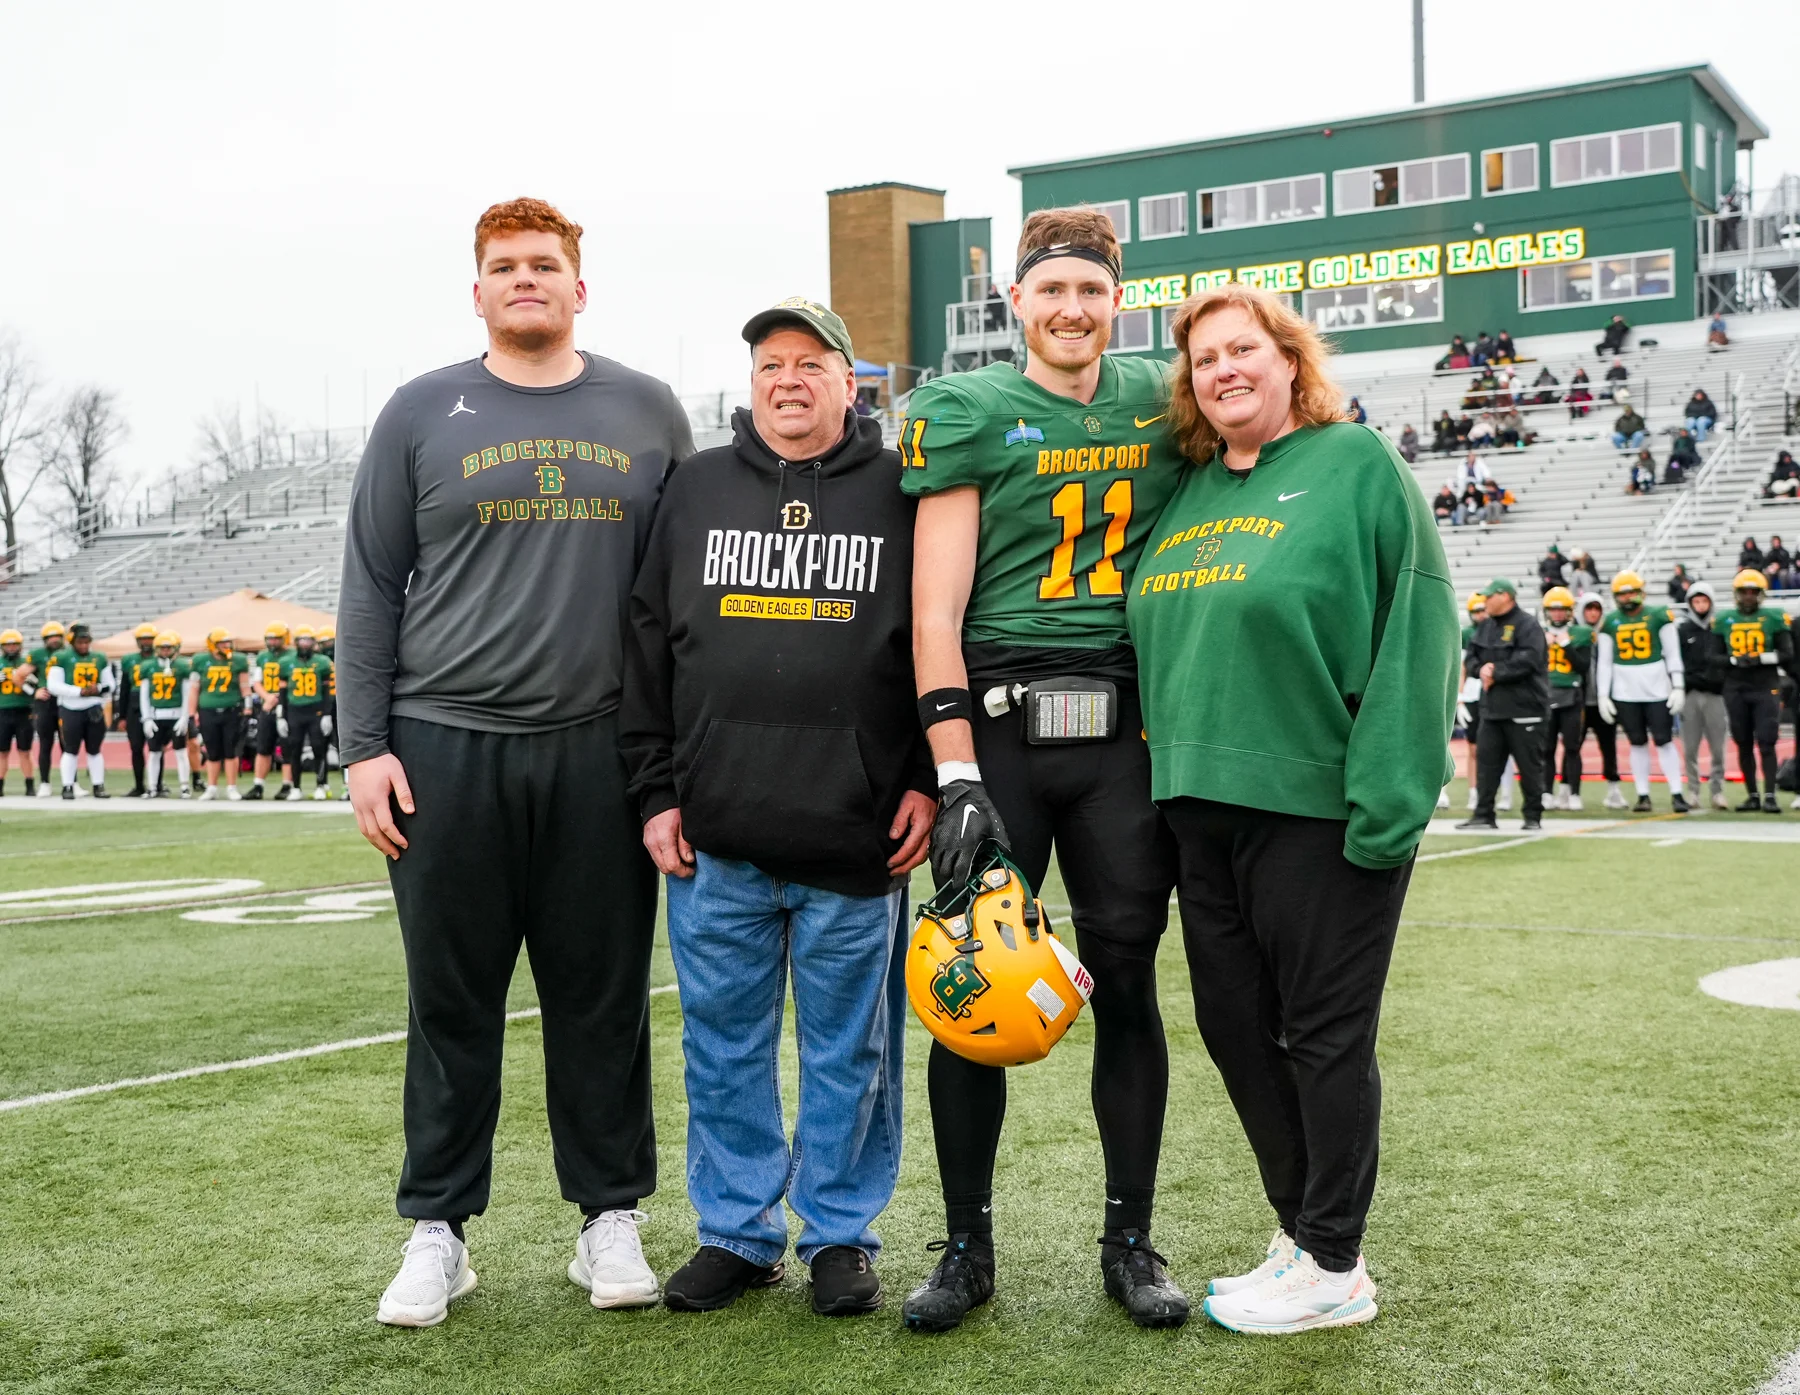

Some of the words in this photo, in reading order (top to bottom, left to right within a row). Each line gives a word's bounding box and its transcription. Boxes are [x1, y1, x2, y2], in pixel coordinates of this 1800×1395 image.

[1121, 275, 1185, 308] OME
[1238, 261, 1303, 293] THE
[1309, 246, 1440, 288] GOLDEN
[1447, 228, 1583, 273] EAGLES
[462, 439, 630, 479] BROCKPORT
[1036, 443, 1150, 475] BROCKPORT
[538, 463, 564, 494] B
[477, 498, 623, 524] FOOTBALL
[783, 501, 810, 529] B
[1036, 477, 1134, 601] 11
[1154, 516, 1285, 557] BROCKPORT
[703, 530, 884, 593] BROCKPORT
[1140, 563, 1247, 596] FOOTBALL
[726, 599, 764, 614] GOLDEN
[767, 601, 807, 616] EAGLES
[816, 601, 852, 619] 1835
[1616, 629, 1651, 660] 59
[1730, 629, 1765, 657] 90
[152, 676, 176, 699] 37
[207, 670, 232, 692] 77
[292, 672, 317, 696] 38
